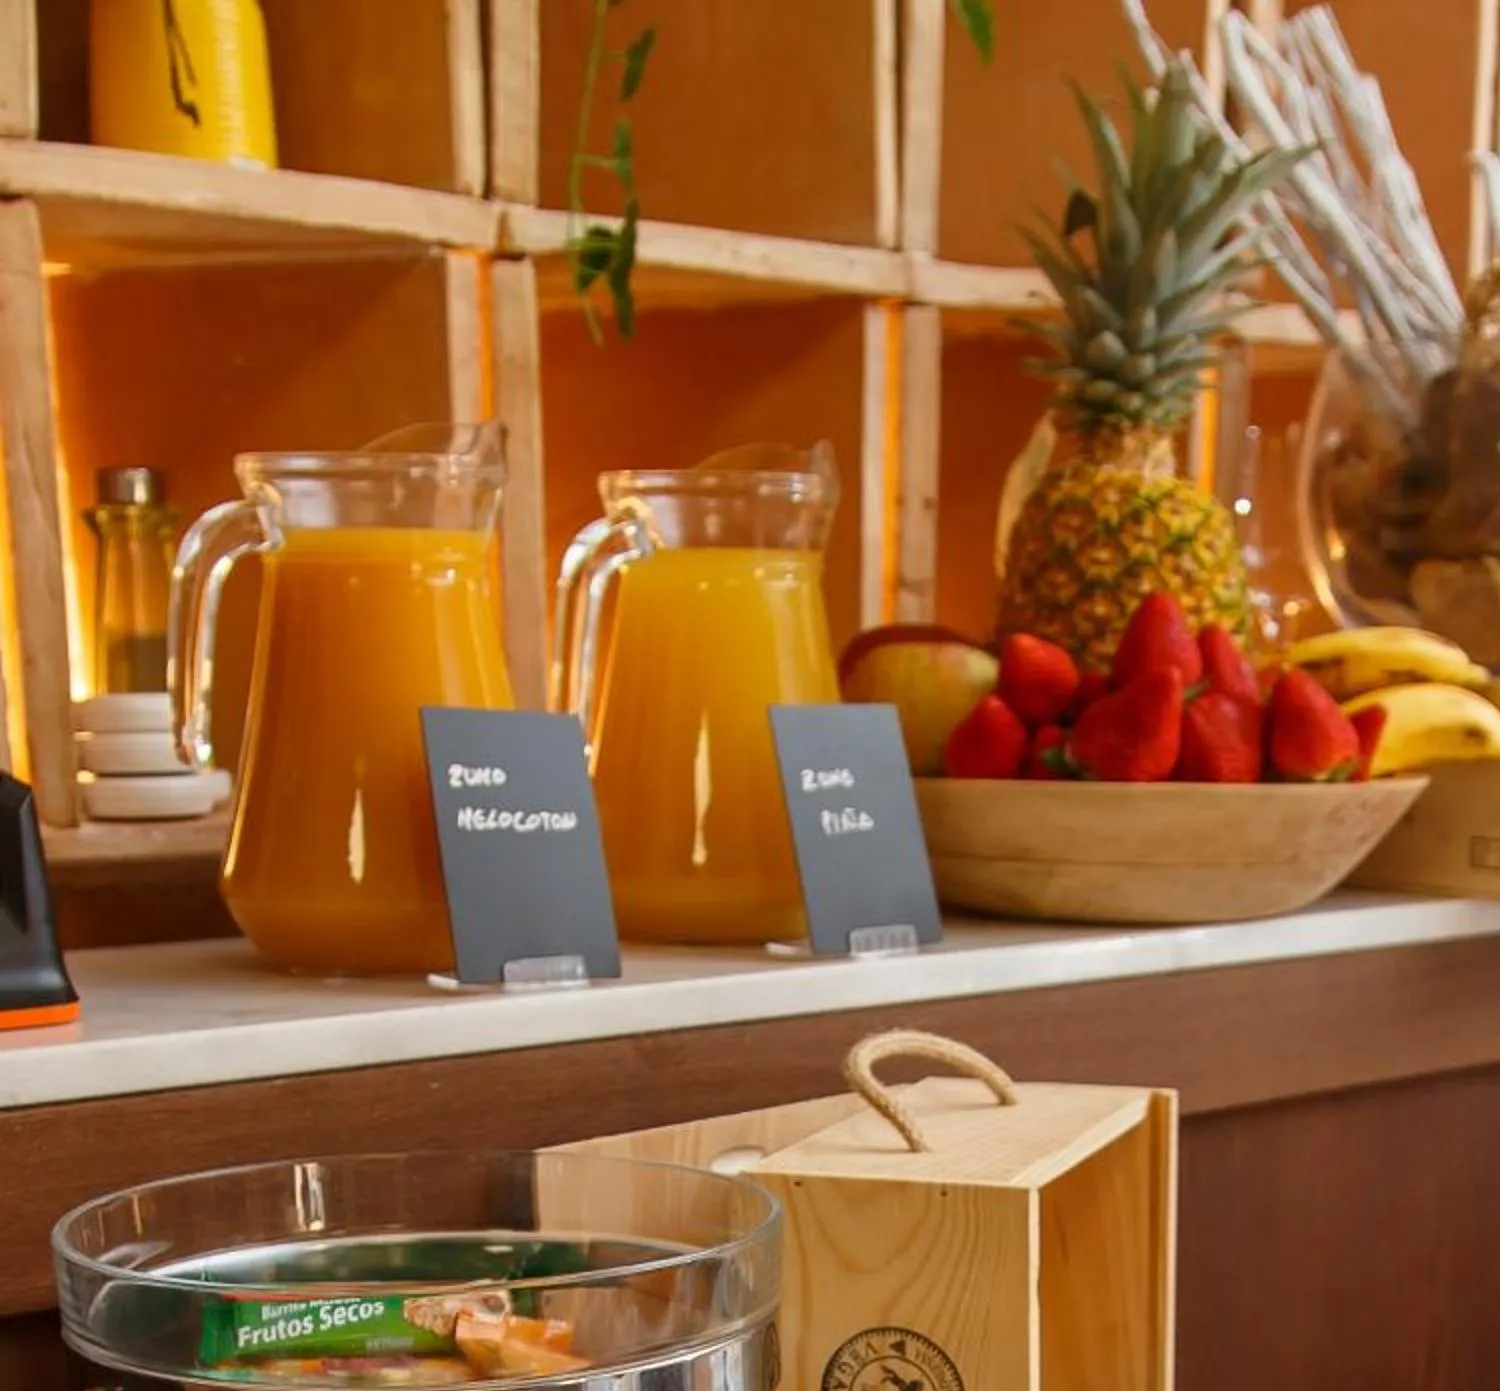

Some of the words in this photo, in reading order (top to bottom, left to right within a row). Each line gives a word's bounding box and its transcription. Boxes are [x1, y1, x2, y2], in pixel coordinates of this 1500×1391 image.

[457, 806, 577, 832] MELOCOTON
[237, 1314, 314, 1348] Frutos
[319, 1301, 385, 1331] Secos
